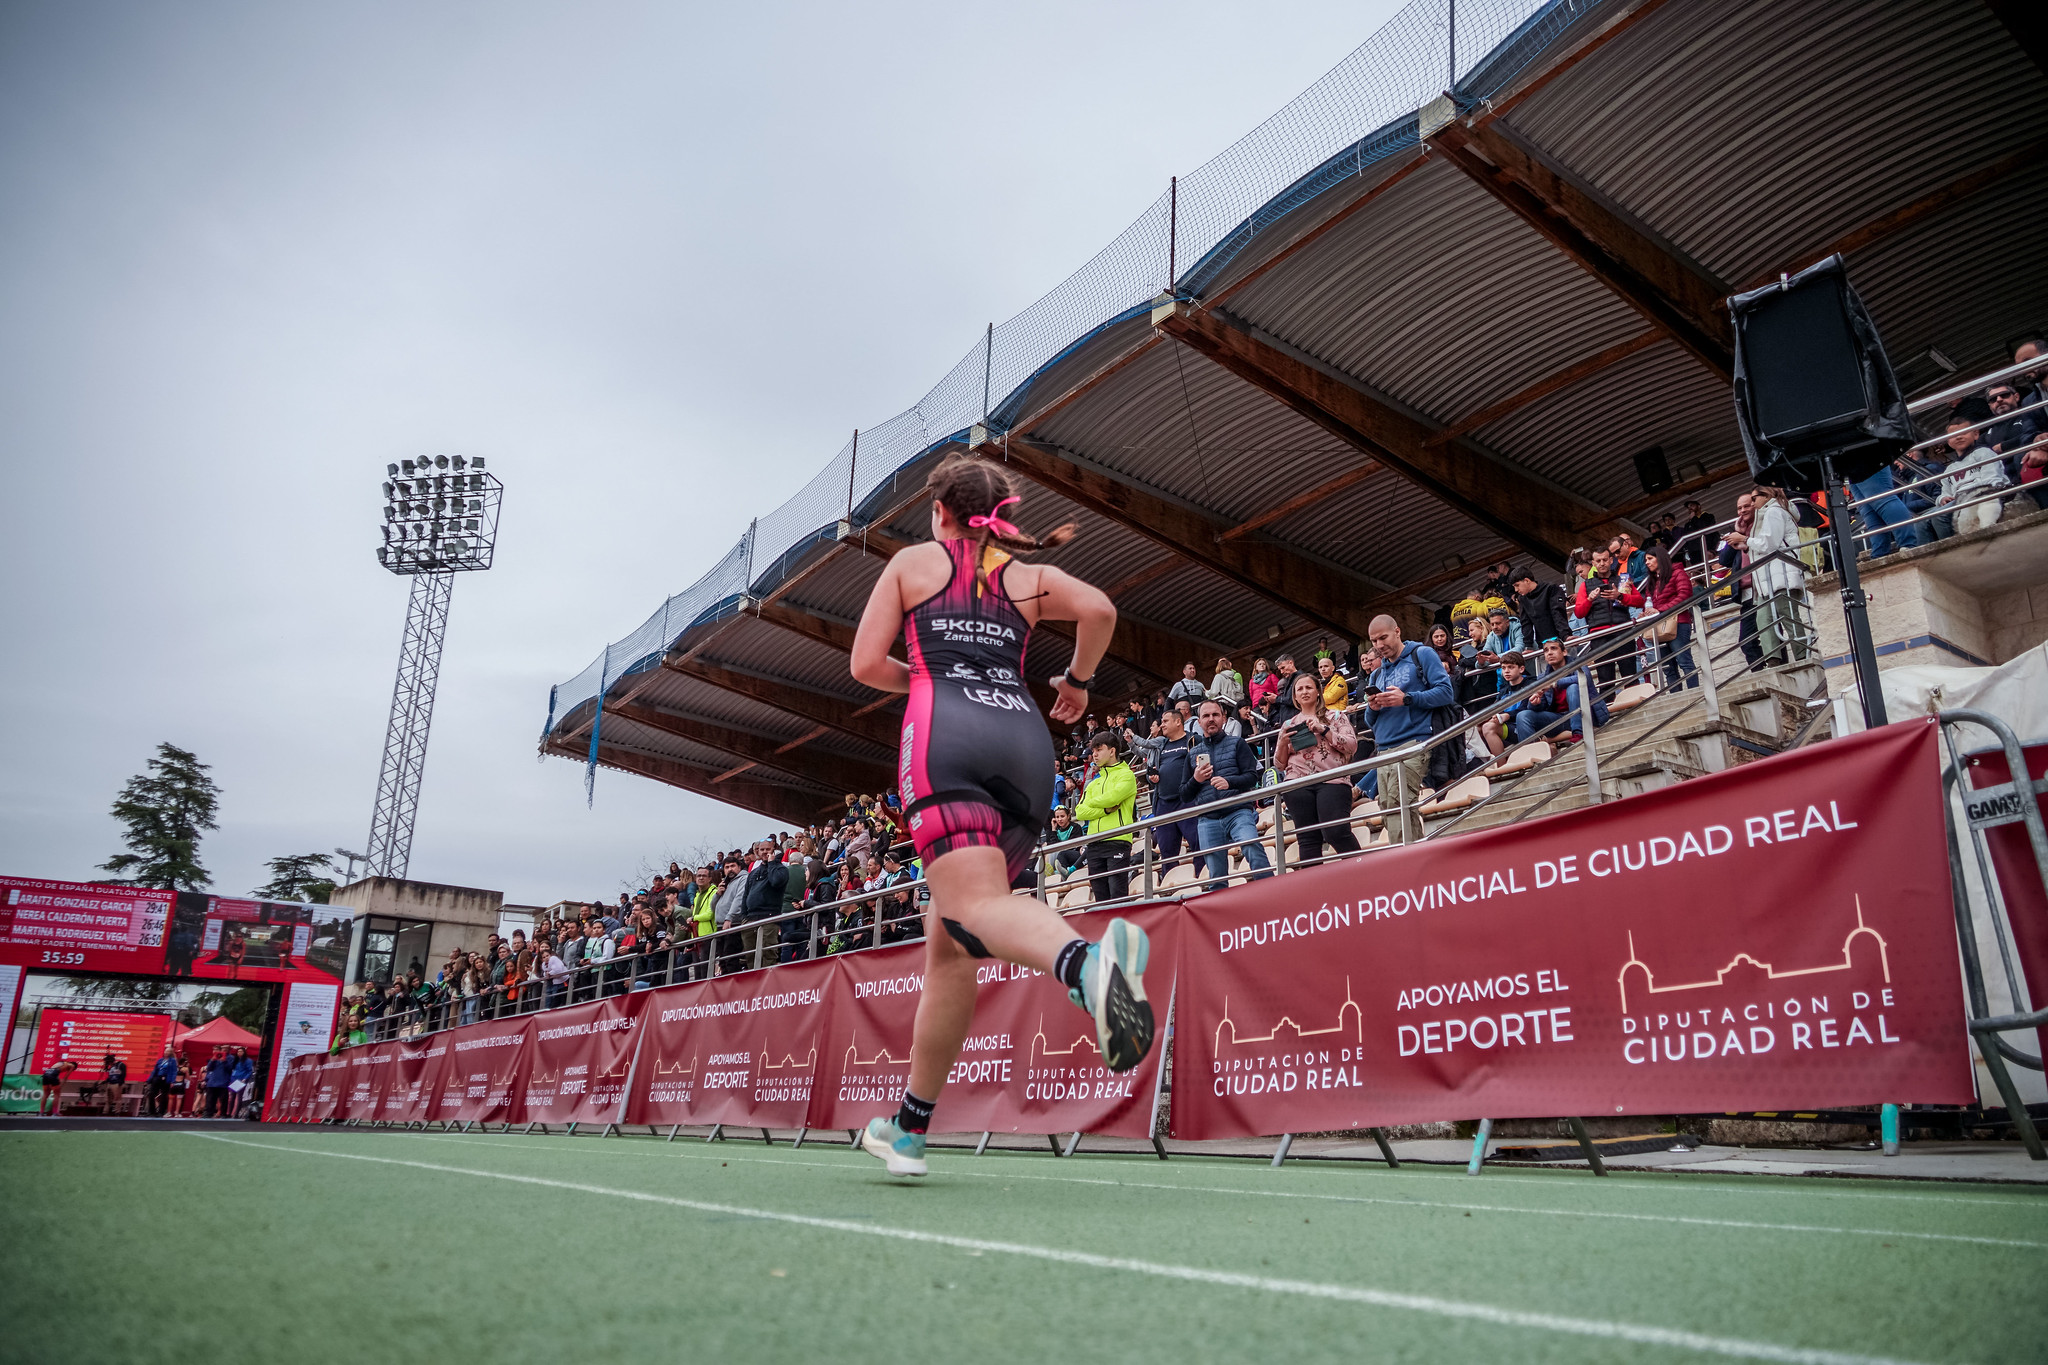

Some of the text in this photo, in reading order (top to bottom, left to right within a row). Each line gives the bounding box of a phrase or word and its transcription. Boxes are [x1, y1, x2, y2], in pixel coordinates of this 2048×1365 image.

[931, 619, 1016, 641] SKODA
[963, 687, 1031, 713] LEÓN
[1219, 801, 1858, 953] DIPUTACIÓN PROVINCIAL DE CIUDAD REAL
[60, 884, 94, 892] ESPAÑA
[96, 888, 137, 896] DUATLÓN
[139, 892, 172, 900] CADETE
[19, 894, 52, 906] ARAITZ
[54, 897, 100, 910] GONZALEZ
[100, 901, 132, 912] GARCIA
[16, 909, 46, 920] NEREA
[47, 912, 94, 924] CALDERÓN
[95, 916, 128, 926] PUERTA
[12, 924, 54, 936] MARTINA
[56, 928, 105, 940] RODRIGUEZ
[106, 932, 128, 942] VEGA
[42, 940, 75, 948] CADETE
[76, 942, 118, 951] FEMENINA
[41, 950, 85, 965] 35:59
[854, 972, 924, 999] DIPUTACIÓN
[1396, 969, 1569, 1011] APOYAMOS EL
[661, 988, 821, 1023] DIPUTACIÓN PROVINCIAL DE CIUDAD REAL
[1622, 988, 1895, 1034] DIPUTACIÓN DE
[1398, 1006, 1574, 1057] DEPORTE
[1624, 1014, 1900, 1064] CIUDAD REAL
[962, 1033, 1014, 1052] YAMOS EL
[708, 1052, 751, 1066] APOYAMOS EL
[1214, 1047, 1364, 1074] DIPUTACIÓN DE
[704, 1070, 750, 1089] DEPORTE
[841, 1074, 903, 1084] DIPUTACIÓN
[947, 1060, 1012, 1084] EPORTE
[1028, 1066, 1114, 1080] DIPUTACIÓN
[1214, 1065, 1363, 1097] CIUDAD REAL
[560, 1080, 587, 1095] DEPORTE
[756, 1076, 814, 1087] DIPUTACIÓN DE
[1026, 1080, 1134, 1100] CIUDAD REAL
[590, 1093, 623, 1105] CIUDAD REA
[649, 1090, 691, 1102] CIUDAD REAL
[754, 1088, 811, 1102] CIUDAD REAL
[839, 1087, 909, 1102] CIUDAD REA
